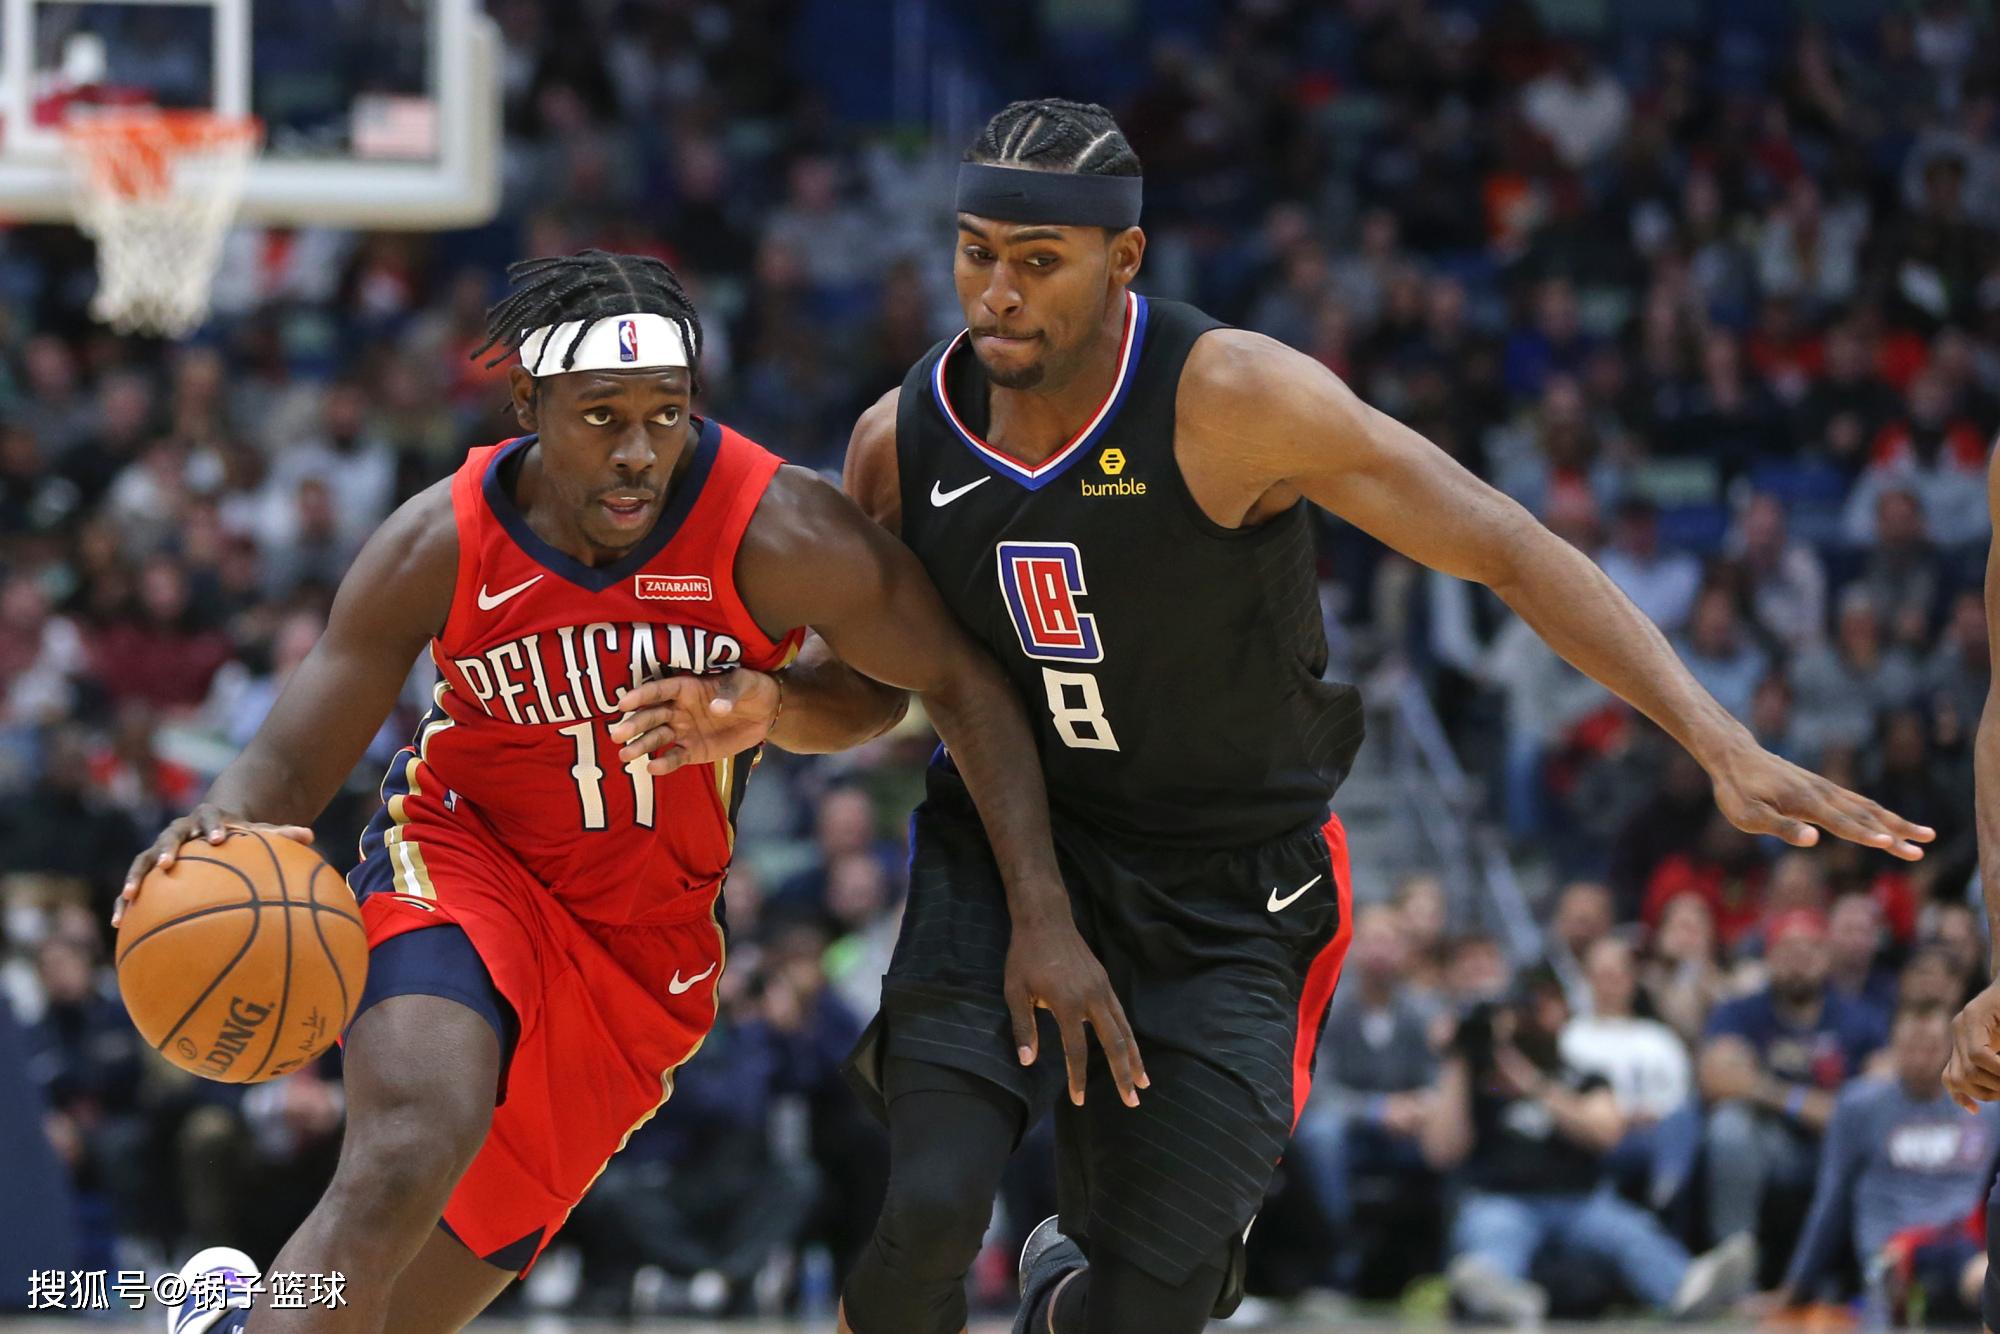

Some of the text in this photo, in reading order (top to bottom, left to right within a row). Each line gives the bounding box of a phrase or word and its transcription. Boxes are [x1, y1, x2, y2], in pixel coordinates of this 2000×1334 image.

[1081, 478, 1147, 497] bumble
[1042, 666, 1120, 752] 8
[558, 710, 657, 832] 11
